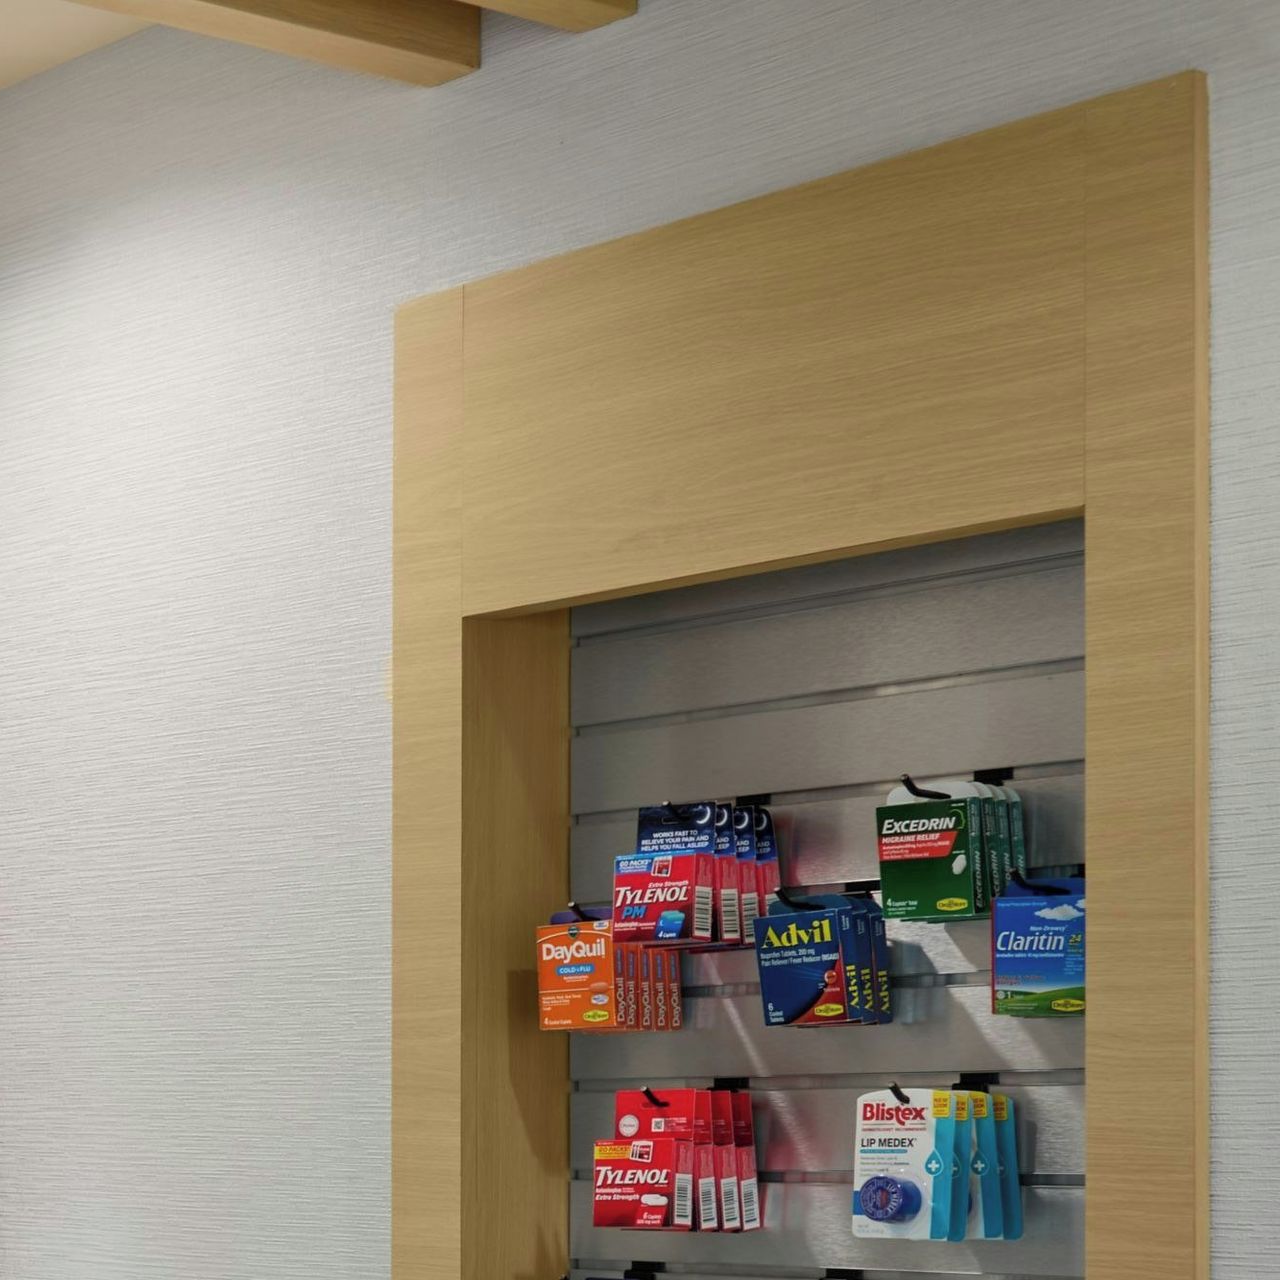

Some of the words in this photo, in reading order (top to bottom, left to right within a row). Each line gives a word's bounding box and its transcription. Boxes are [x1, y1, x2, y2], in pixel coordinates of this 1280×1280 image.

[882, 817, 957, 834] EXCEDRIN
[615, 887, 689, 908] TYLENOL
[622, 906, 646, 919] PM
[761, 918, 832, 949] Advil
[996, 931, 1064, 951] Claritin
[542, 938, 605, 962] DayQuil
[862, 1103, 925, 1126] Blistex
[861, 1138, 875, 1148] LIP
[878, 1137, 914, 1148] MEDEX
[595, 1166, 669, 1186] TYLENOL
[614, 1193, 640, 1201] Strength
